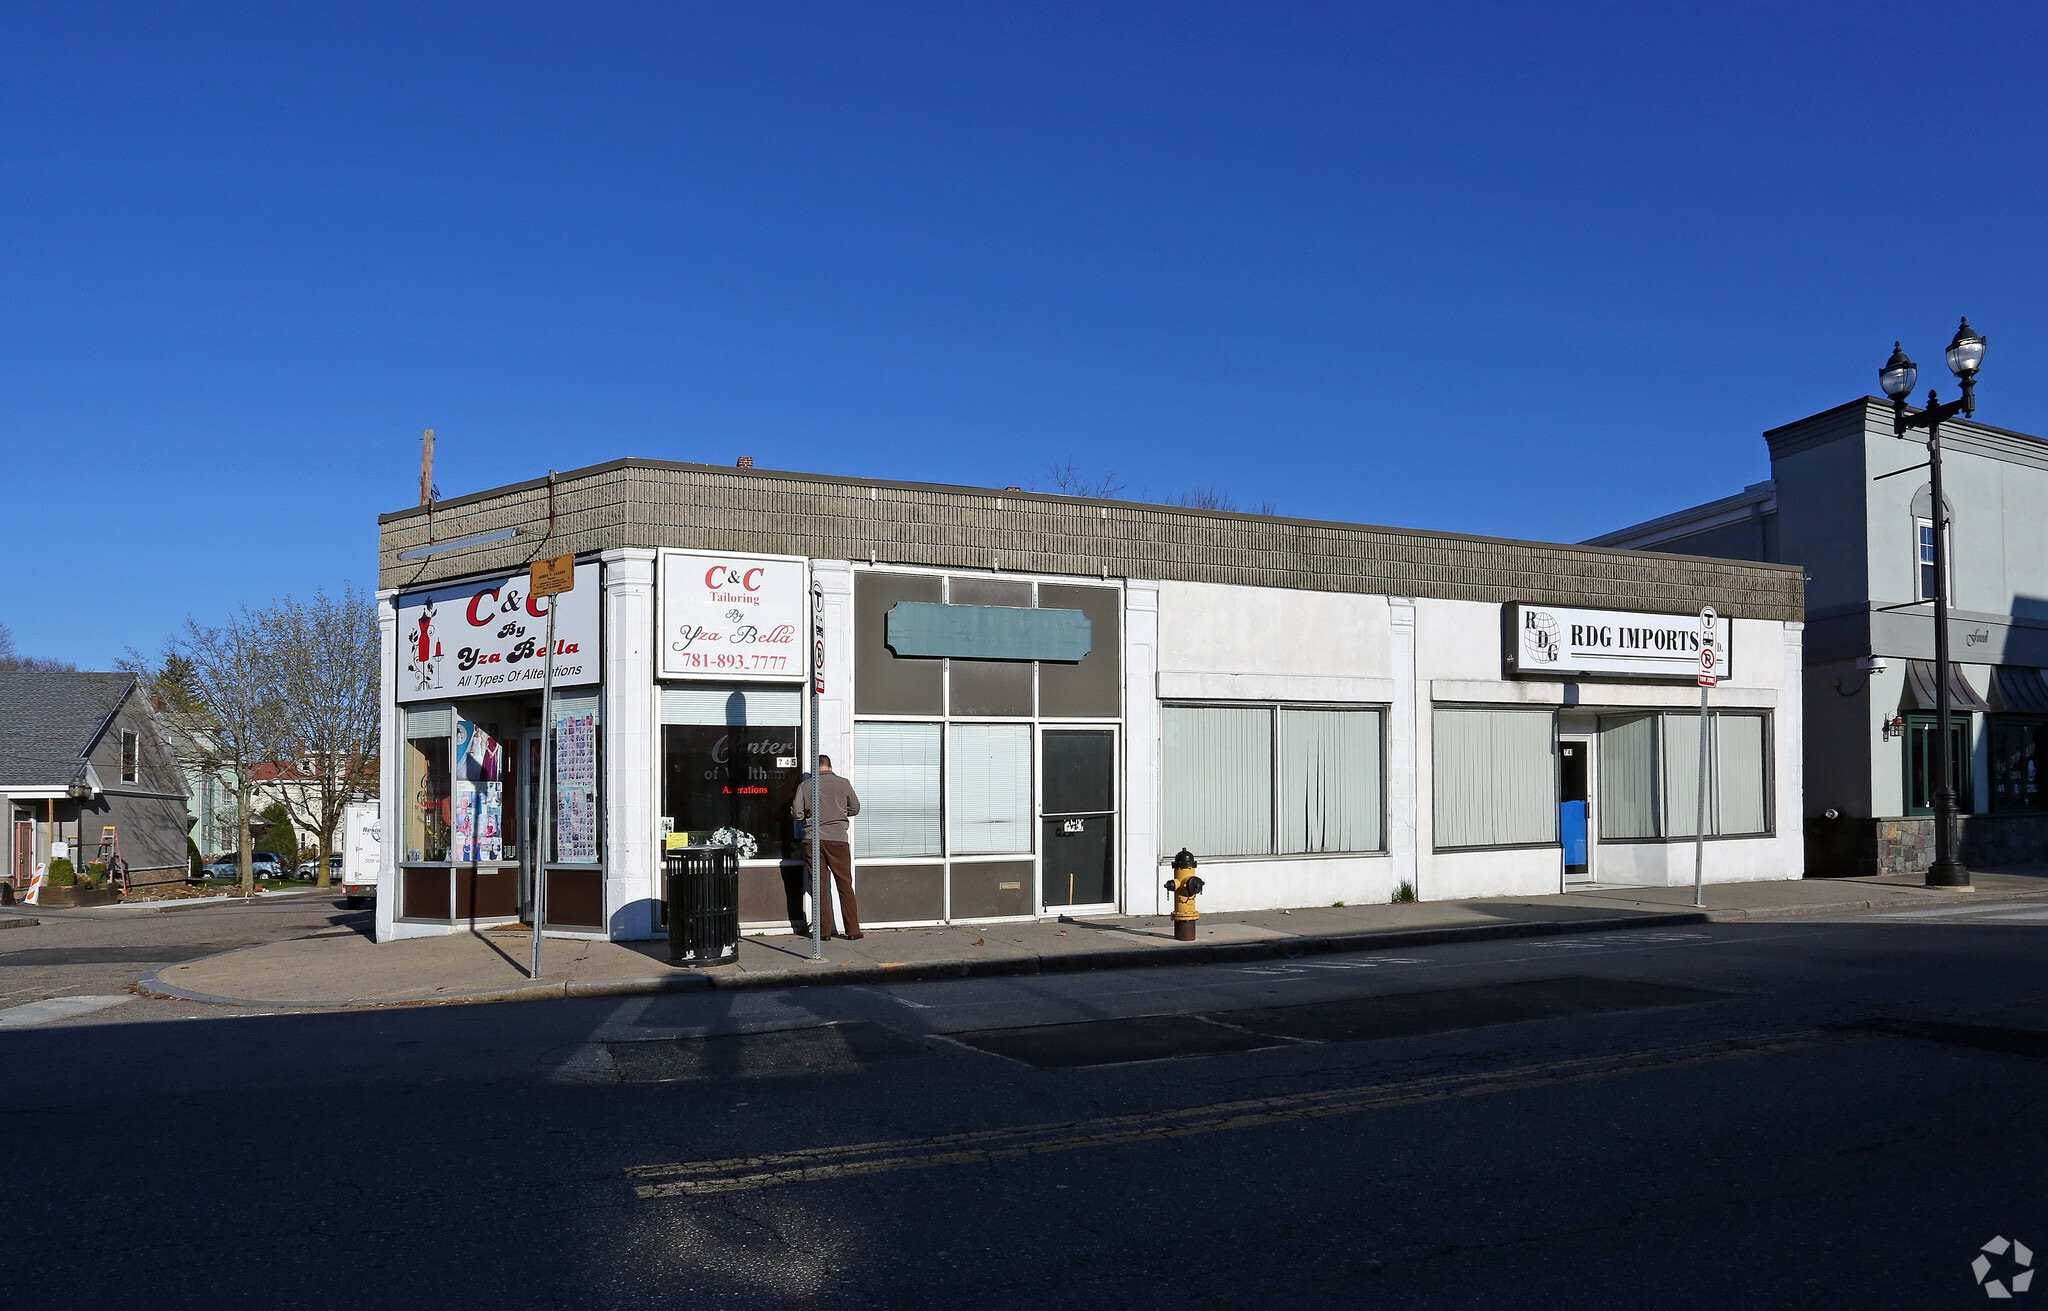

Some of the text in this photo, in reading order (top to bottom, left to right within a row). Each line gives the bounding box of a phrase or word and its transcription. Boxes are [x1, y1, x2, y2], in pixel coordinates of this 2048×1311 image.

[710, 591, 760, 606] Tailoring
[725, 608, 745, 623] By
[497, 620, 526, 639] By
[672, 624, 795, 652] Yza Bella
[1570, 624, 1612, 648] RDG
[1618, 627, 1699, 652] IMPORTS
[457, 646, 502, 671] Yza
[457, 665, 583, 688] All Types Of Altetions
[711, 734, 795, 764] Cnter
[778, 758, 796, 766] 745
[704, 766, 785, 780] of ltham
[722, 785, 769, 794] Arations
